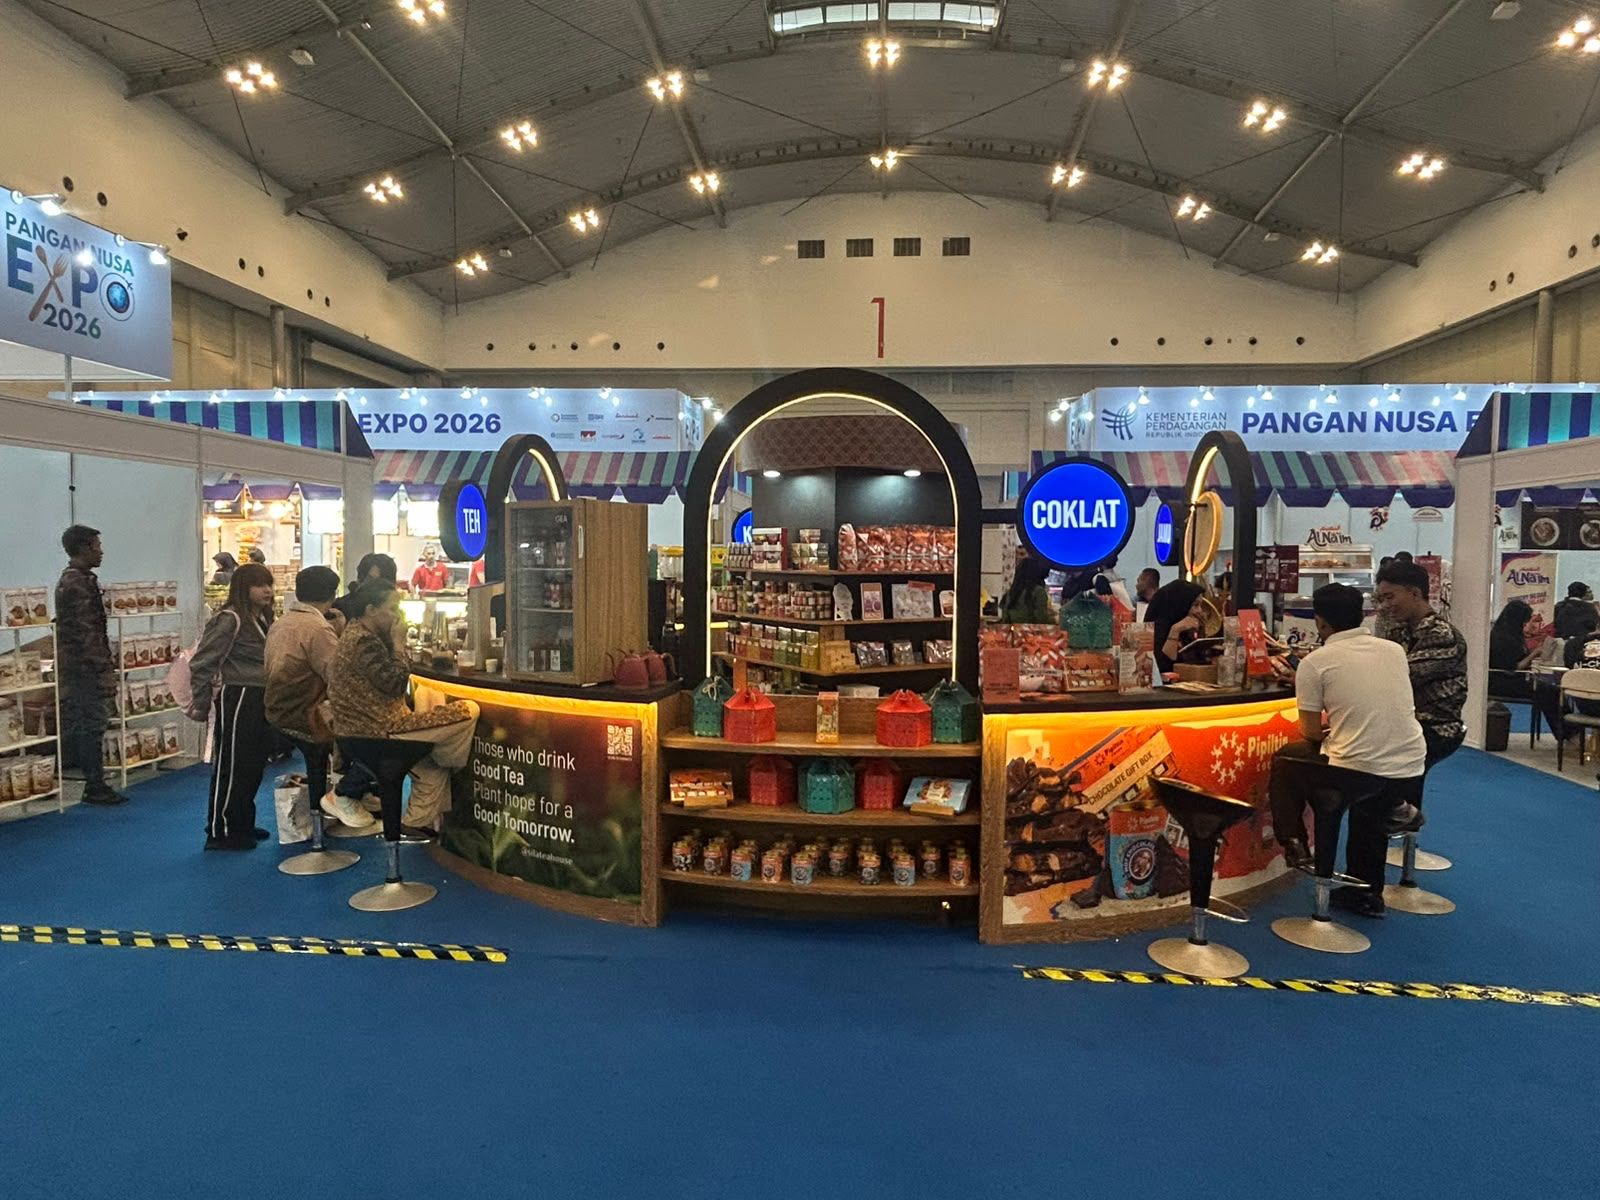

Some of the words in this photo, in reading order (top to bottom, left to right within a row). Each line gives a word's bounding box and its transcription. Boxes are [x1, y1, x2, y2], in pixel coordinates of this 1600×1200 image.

[90, 244, 135, 278] NUSA
[42, 303, 102, 340] 2026
[870, 297, 885, 358] 1
[358, 413, 428, 434] EXPO
[433, 413, 502, 434] 2026
[1145, 412, 1228, 421] KEMENTERIAN
[1145, 421, 1227, 430] PERDAGANGAN
[1242, 412, 1368, 434] PANGAN
[1374, 411, 1458, 433] NUSA
[463, 508, 481, 534] TEH
[1032, 499, 1121, 529] COKLAT
[474, 736, 504, 759] Those
[506, 745, 533, 765] who
[538, 748, 576, 771] drink
[1247, 731, 1289, 762] Pipiltin
[473, 758, 500, 780] Good
[502, 765, 524, 786] Tea
[1088, 774, 1127, 805] CHOCOLATE
[1125, 762, 1141, 780] GIFT
[1138, 751, 1153, 768] BOX
[473, 780, 502, 803] Plant
[504, 789, 536, 812] hope
[540, 797, 560, 816] for
[564, 804, 573, 819] a
[473, 804, 500, 826] Good
[503, 812, 575, 843] Tomorrow.
